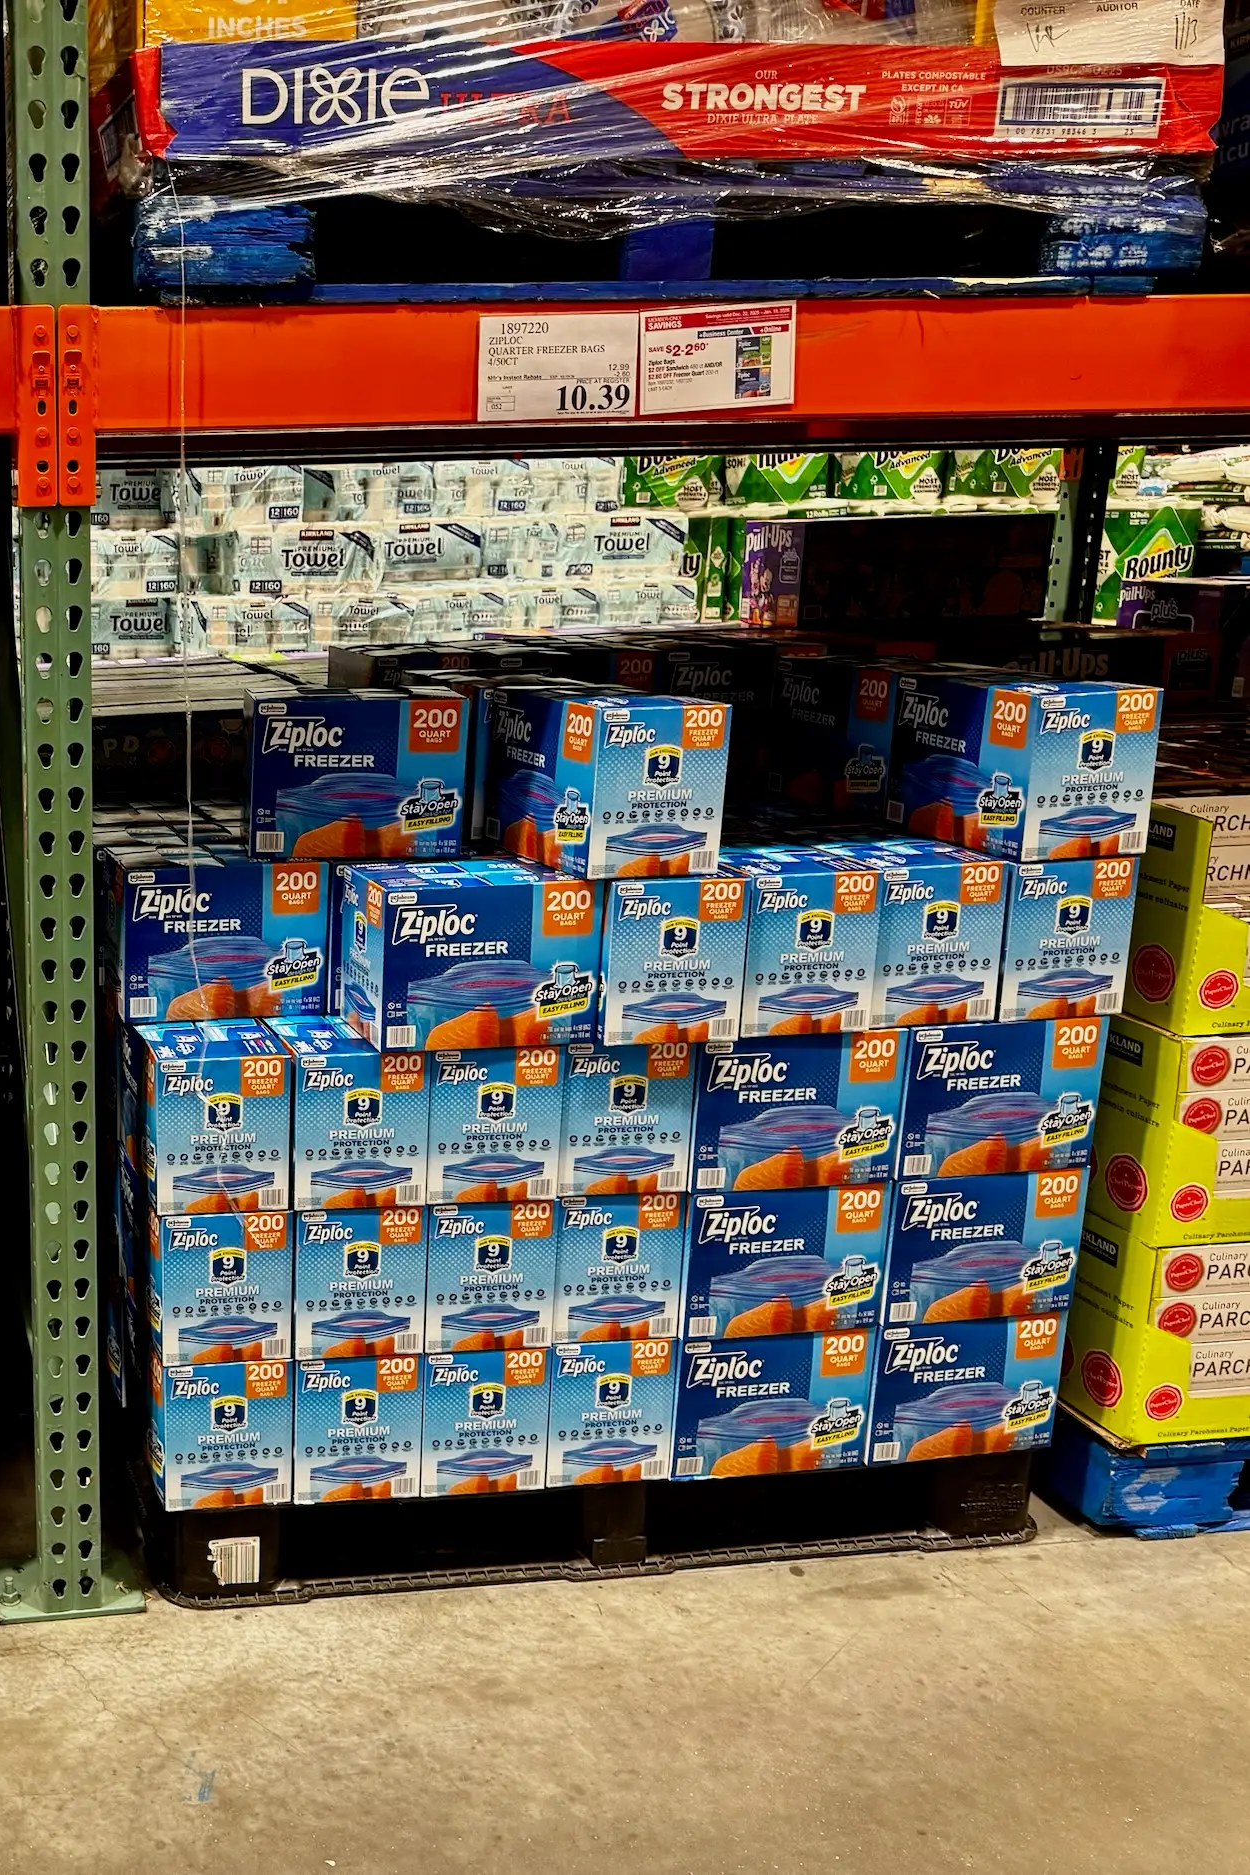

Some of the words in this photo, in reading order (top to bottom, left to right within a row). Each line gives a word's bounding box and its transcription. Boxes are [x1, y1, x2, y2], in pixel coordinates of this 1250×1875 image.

[1021, 6, 1066, 16] COUNTER
[1096, 3, 1138, 13] AUDITOR
[208, 16, 306, 38] INCHES
[755, 70, 778, 80] OUR
[882, 71, 916, 80] PLATES
[919, 71, 986, 81] COMPOSTABLE
[902, 83, 937, 93] EXCEPT
[938, 84, 948, 92] IN
[951, 84, 964, 93] CA
[661, 83, 866, 112] STRONGEST
[707, 114, 740, 124] DIXIE
[742, 114, 777, 125] ULTRA
[784, 114, 818, 124] PLATE
[501, 322, 549, 334] 1897220
[648, 321, 682, 330] SAVINGS
[489, 336, 523, 345] ZIPLOC
[489, 347, 534, 356] QUARTER
[537, 346, 578, 354] FREEZER
[581, 345, 605, 353] BAGS
[488, 357, 518, 366] 4/50CT
[556, 384, 630, 411] 10.39
[653, 458, 696, 476] Advanced
[1039, 475, 1057, 483] MOST
[301, 530, 333, 539] KIRKLAND
[594, 533, 649, 552] Towel
[281, 549, 345, 568] Towel
[1125, 545, 1194, 579] Bounty
[414, 708, 458, 729] 200
[686, 709, 723, 728] 200
[270, 721, 343, 753] Ziploc
[419, 730, 451, 738] QUART
[609, 726, 656, 745] Ziploc
[689, 728, 719, 736] FREEZER
[294, 755, 375, 768] FREEZER
[658, 755, 670, 770] 9
[654, 770, 671, 778] Point
[645, 776, 678, 784] Protection
[628, 789, 693, 802] PREMIUM
[631, 801, 687, 809] PROTECTION
[1190, 804, 1229, 814] Culinary
[1210, 1253, 1248, 1262] Culinary
[1202, 1302, 1240, 1311] Culinary
[1164, 1317, 1191, 1327] PaperChef
[1019, 1318, 1057, 1339] 200
[1024, 1337, 1052, 1348] QUART
[893, 1342, 959, 1373] Ziploc
[913, 1366, 985, 1384] FREEZER
[1158, 1429, 1188, 1437] Culinary
[1191, 1427, 1228, 1435] Parchment
